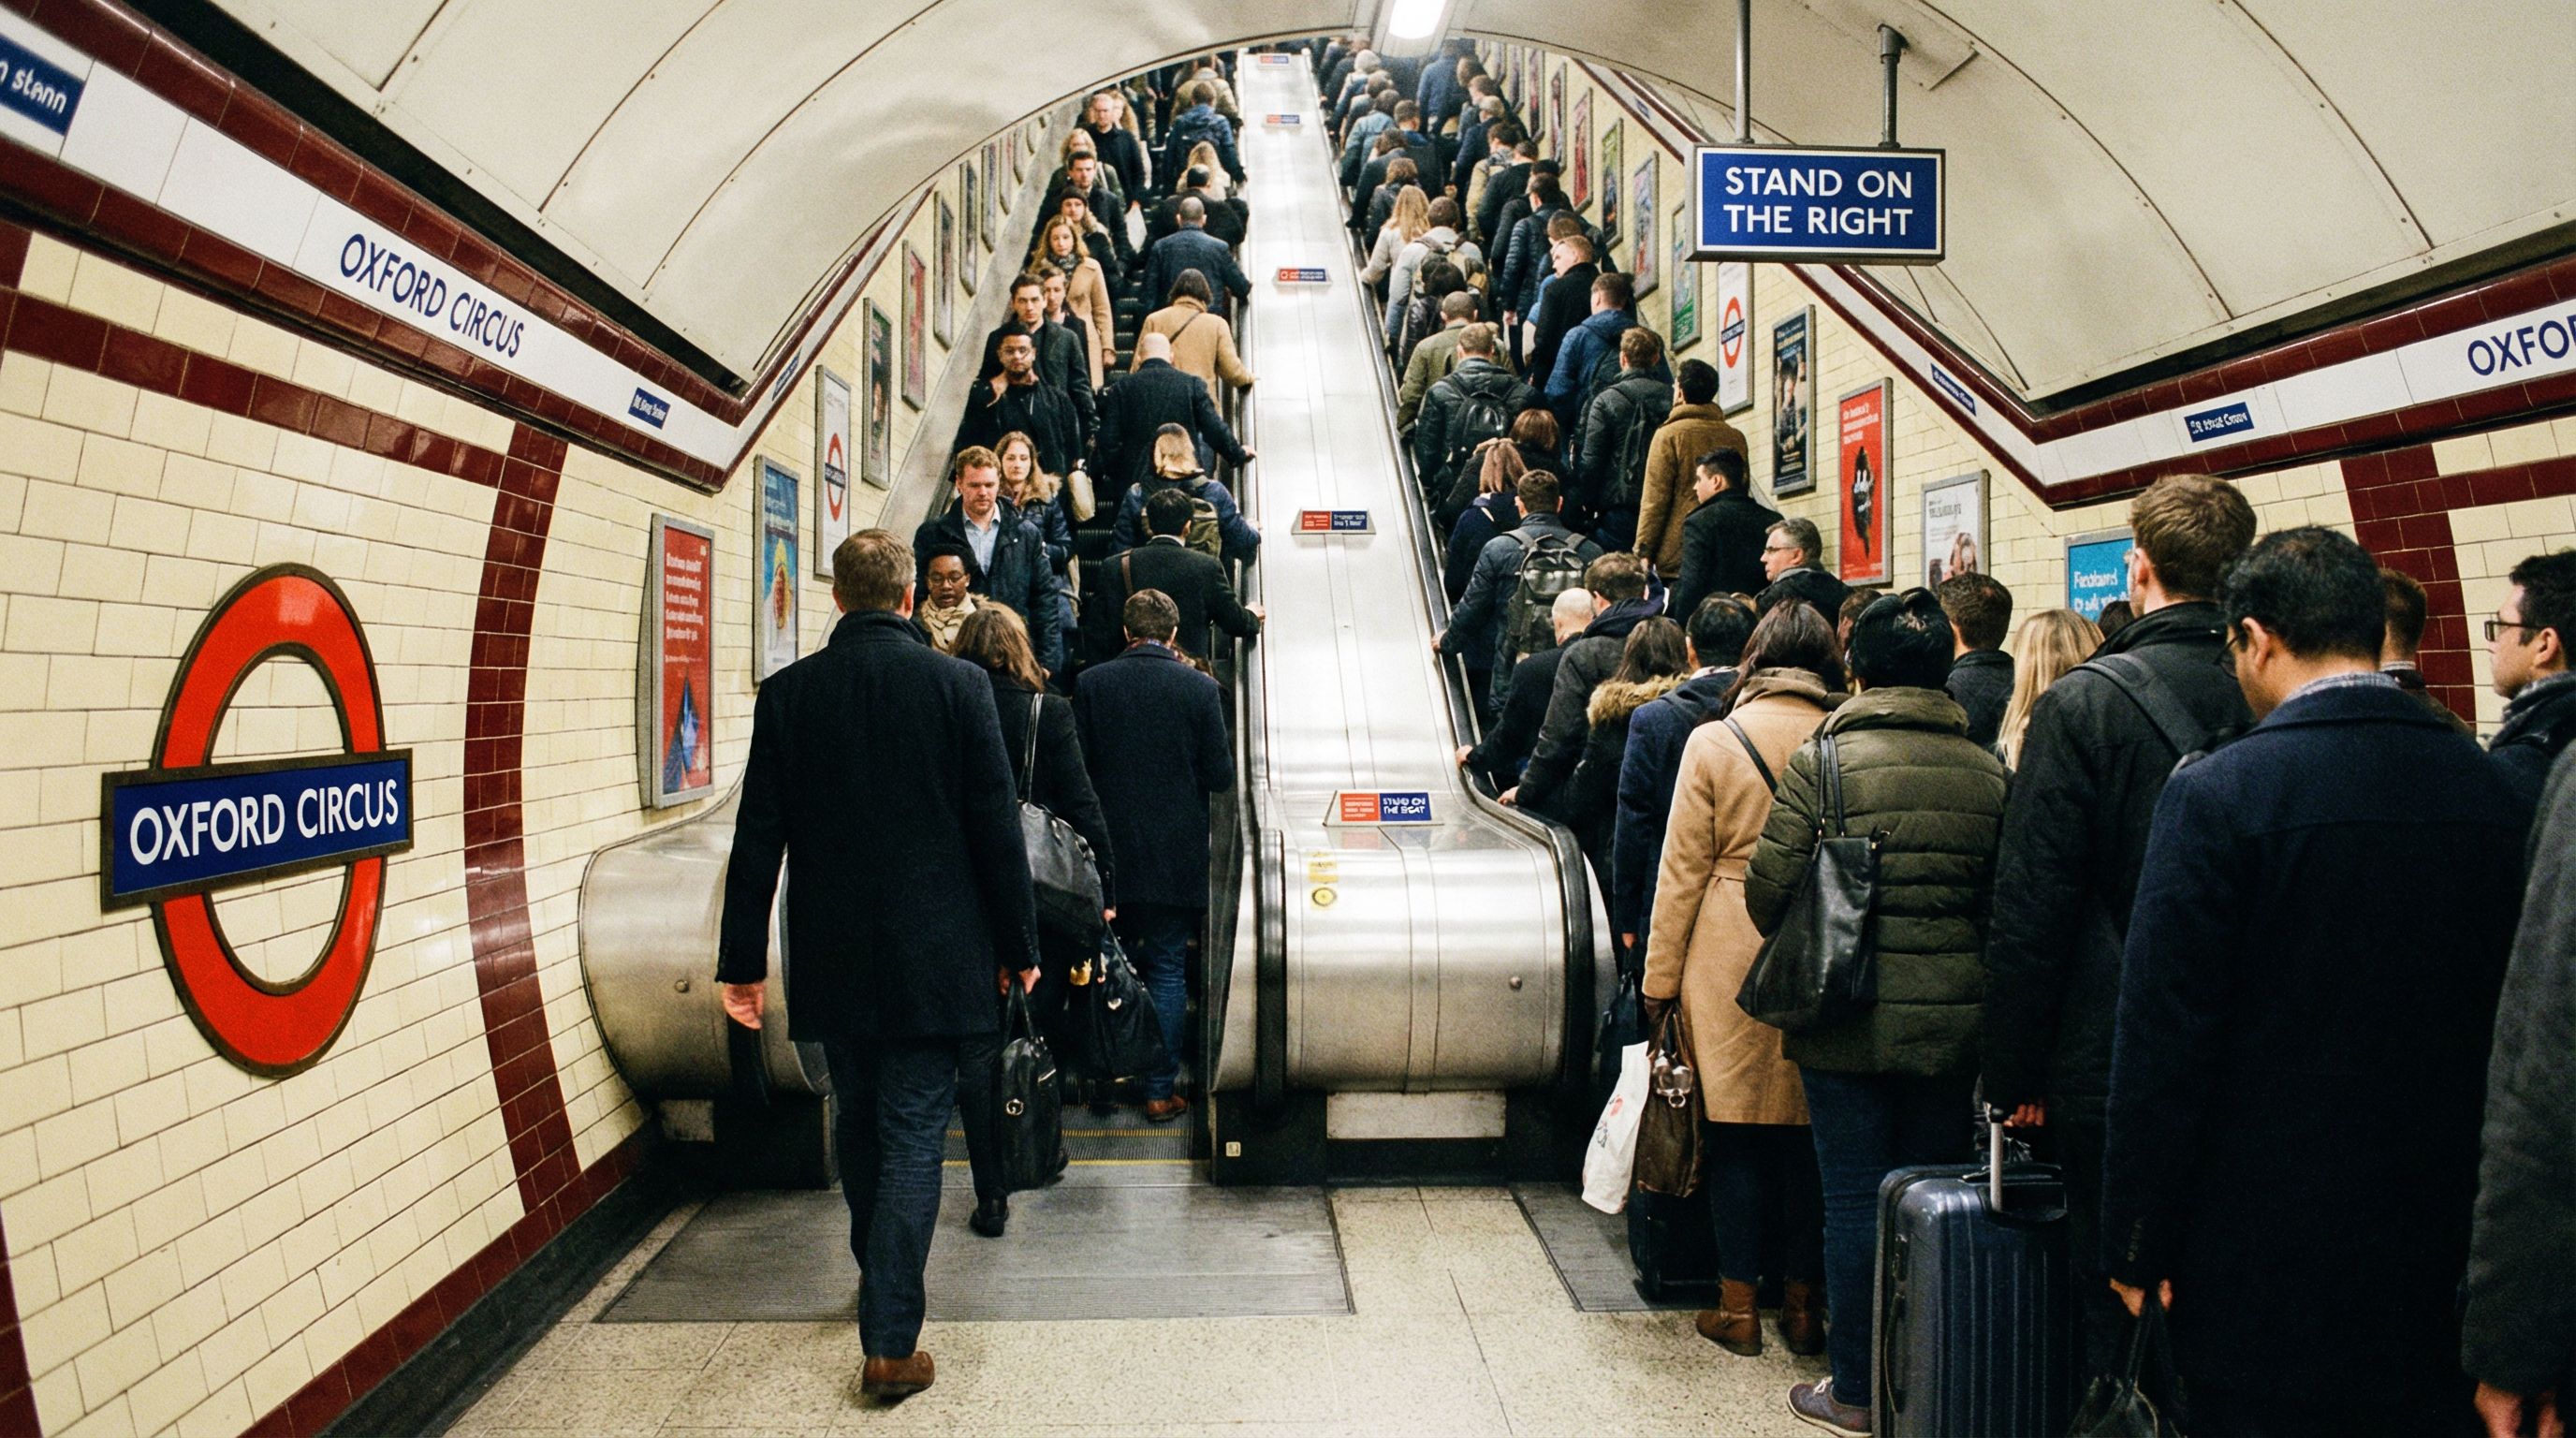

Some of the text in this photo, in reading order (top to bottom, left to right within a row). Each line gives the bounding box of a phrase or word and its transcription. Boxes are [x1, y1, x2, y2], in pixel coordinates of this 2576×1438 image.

[1725, 166, 1911, 198] STAND ON
[1723, 204, 1913, 236] THE RIGHT
[340, 233, 524, 358] OXFORD CIRCUS
[129, 779, 399, 865] OXFORD CIRCUS
